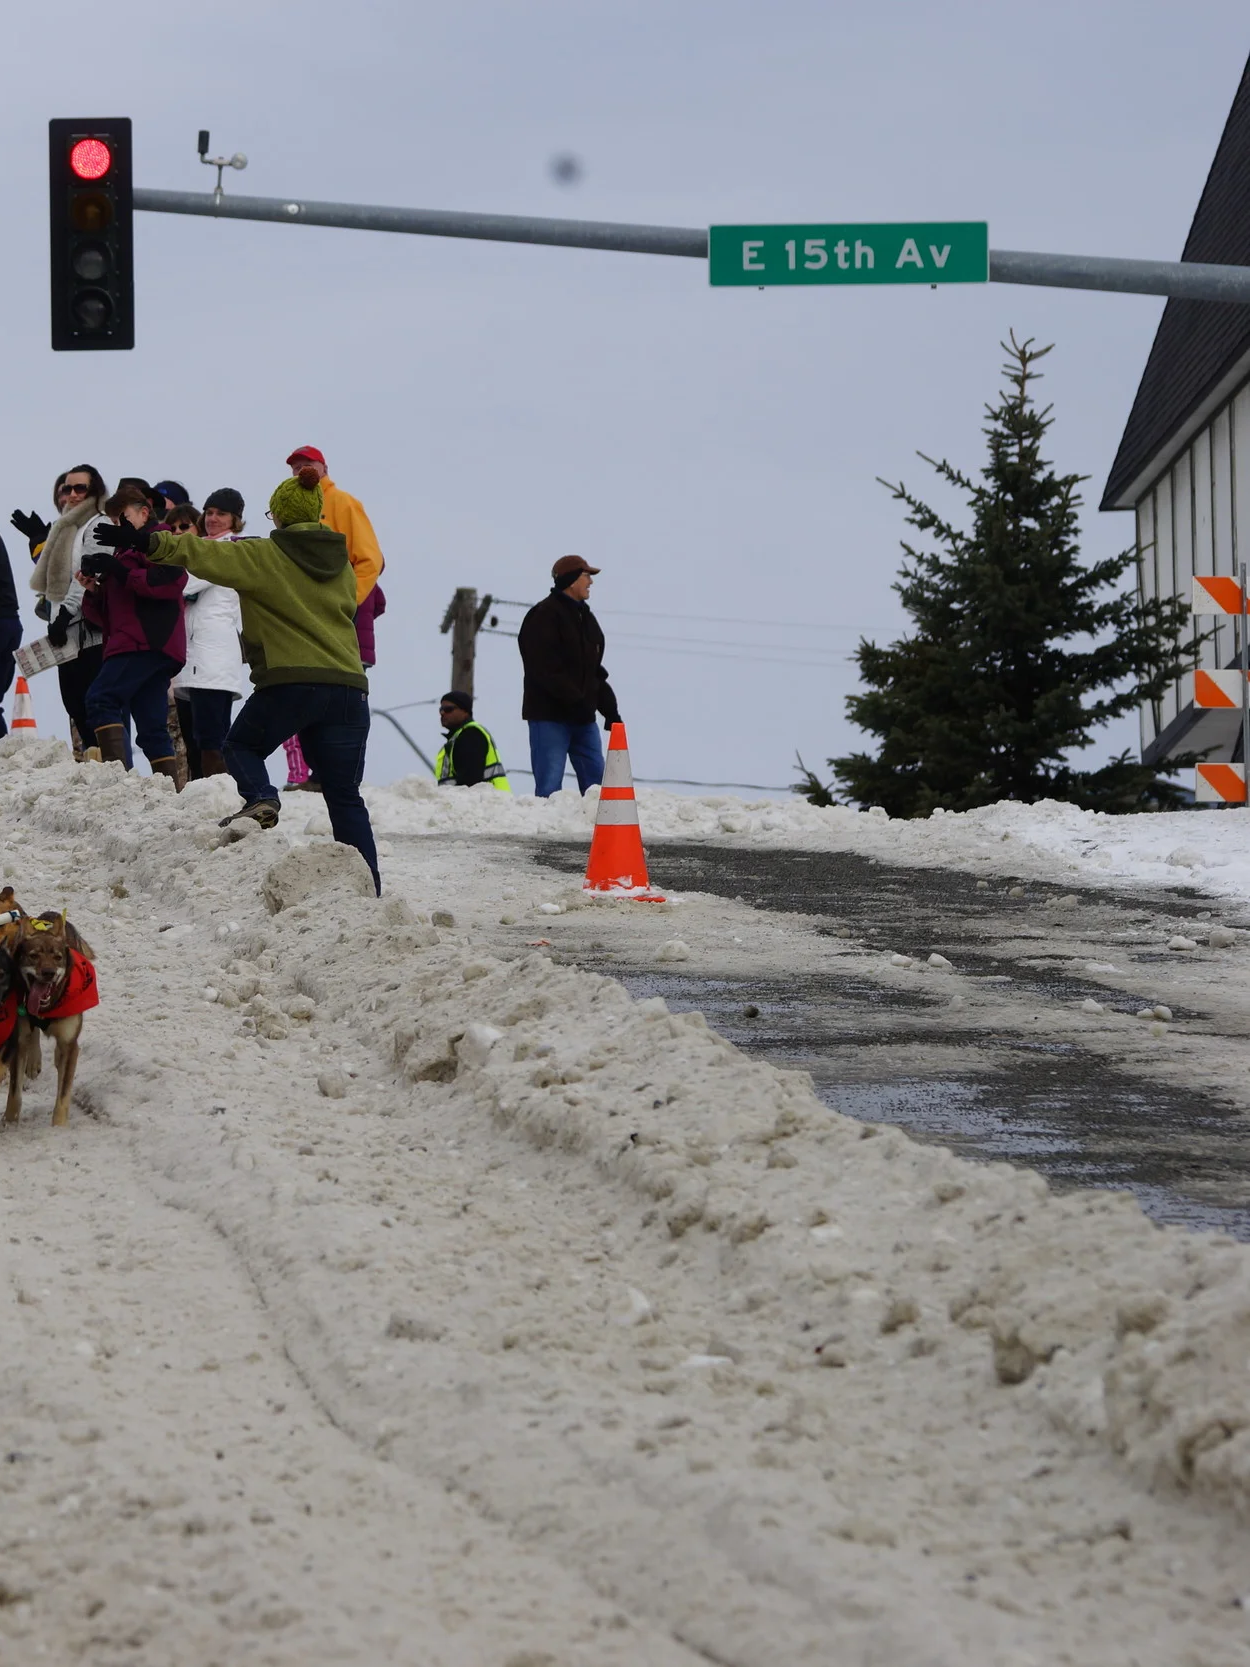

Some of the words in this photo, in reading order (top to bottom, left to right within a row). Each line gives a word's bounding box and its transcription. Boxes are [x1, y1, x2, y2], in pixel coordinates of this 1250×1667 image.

[742, 240, 765, 271] E
[784, 238, 875, 271] 15th
[895, 238, 952, 269] Av
